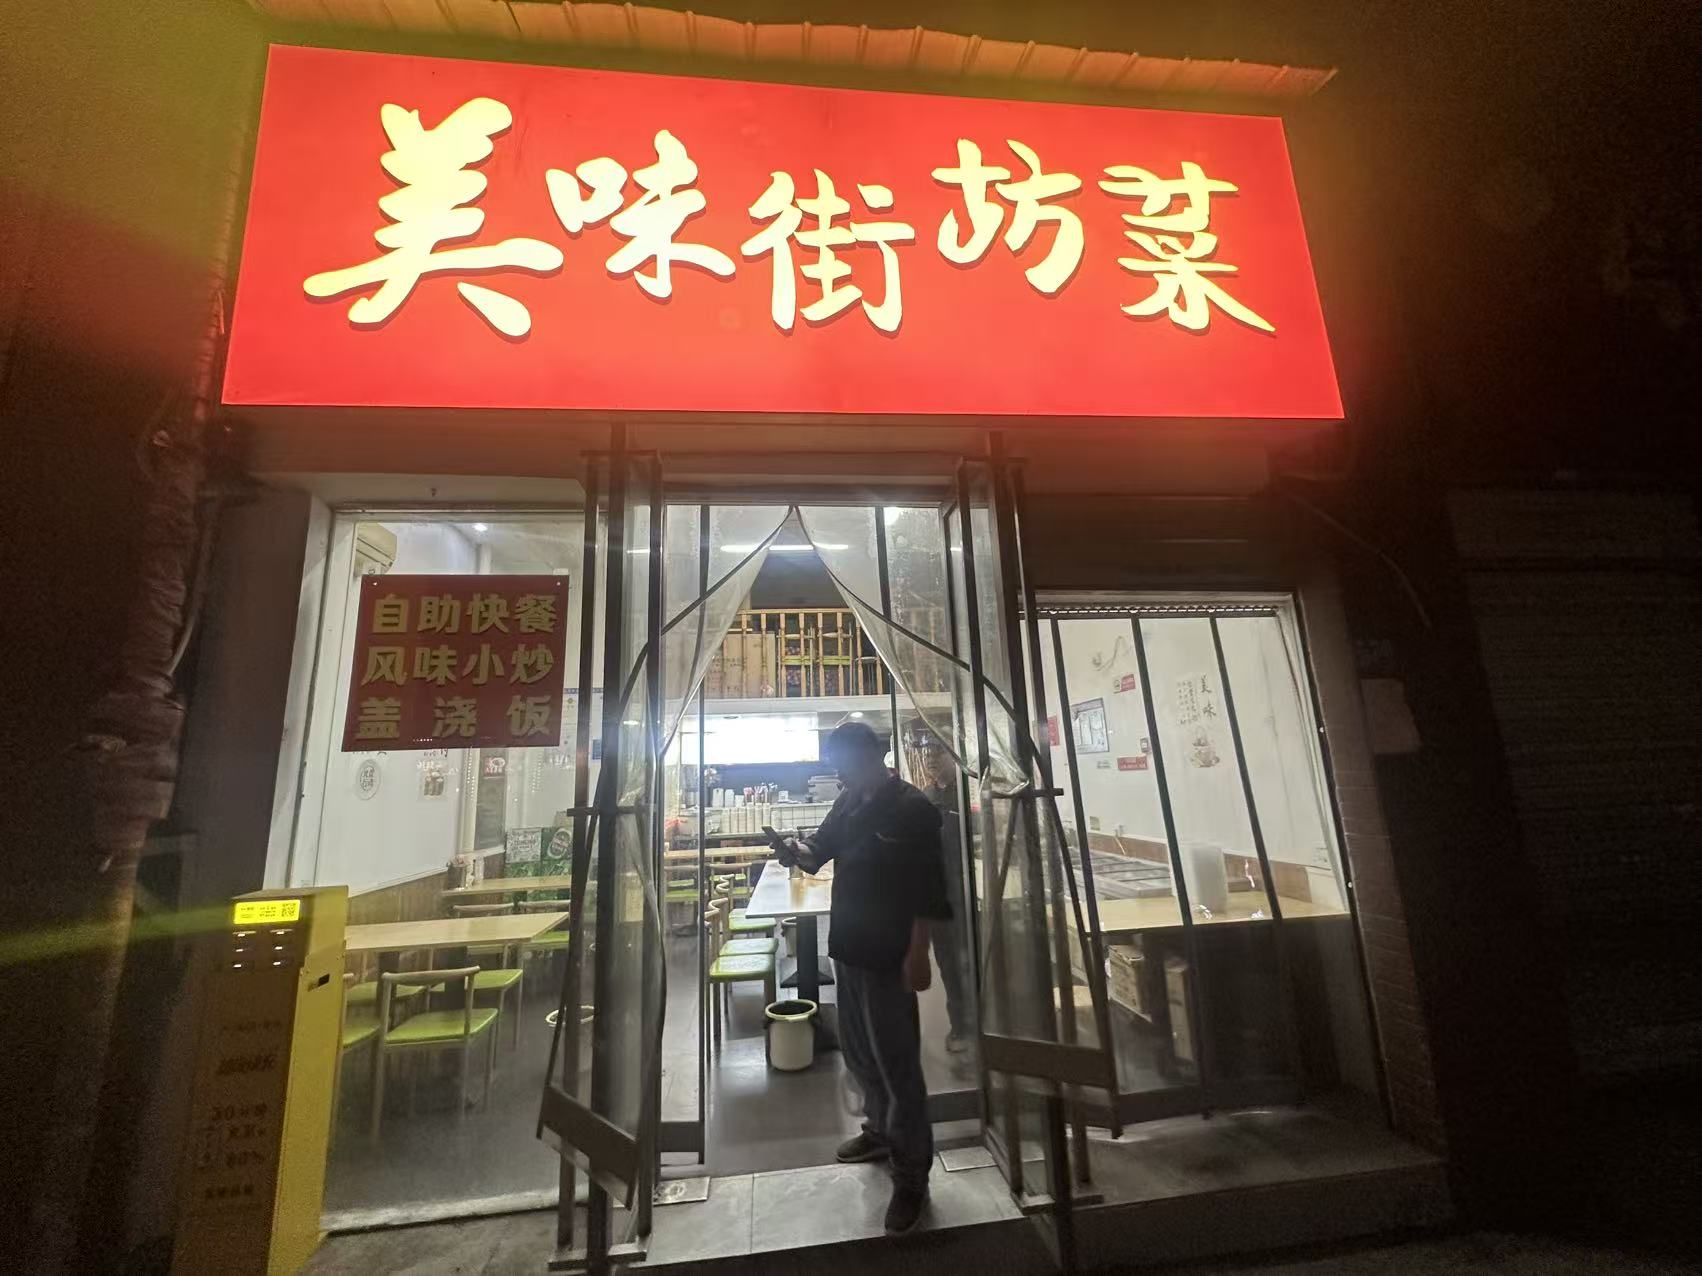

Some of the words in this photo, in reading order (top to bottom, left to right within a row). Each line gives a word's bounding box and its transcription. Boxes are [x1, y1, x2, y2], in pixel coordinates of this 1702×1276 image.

[303, 97, 1276, 337] 美味街坊菜
[372, 593, 558, 635] 自助快餐
[361, 644, 555, 687] 风味小炒
[355, 695, 552, 740] 盖浇饭
